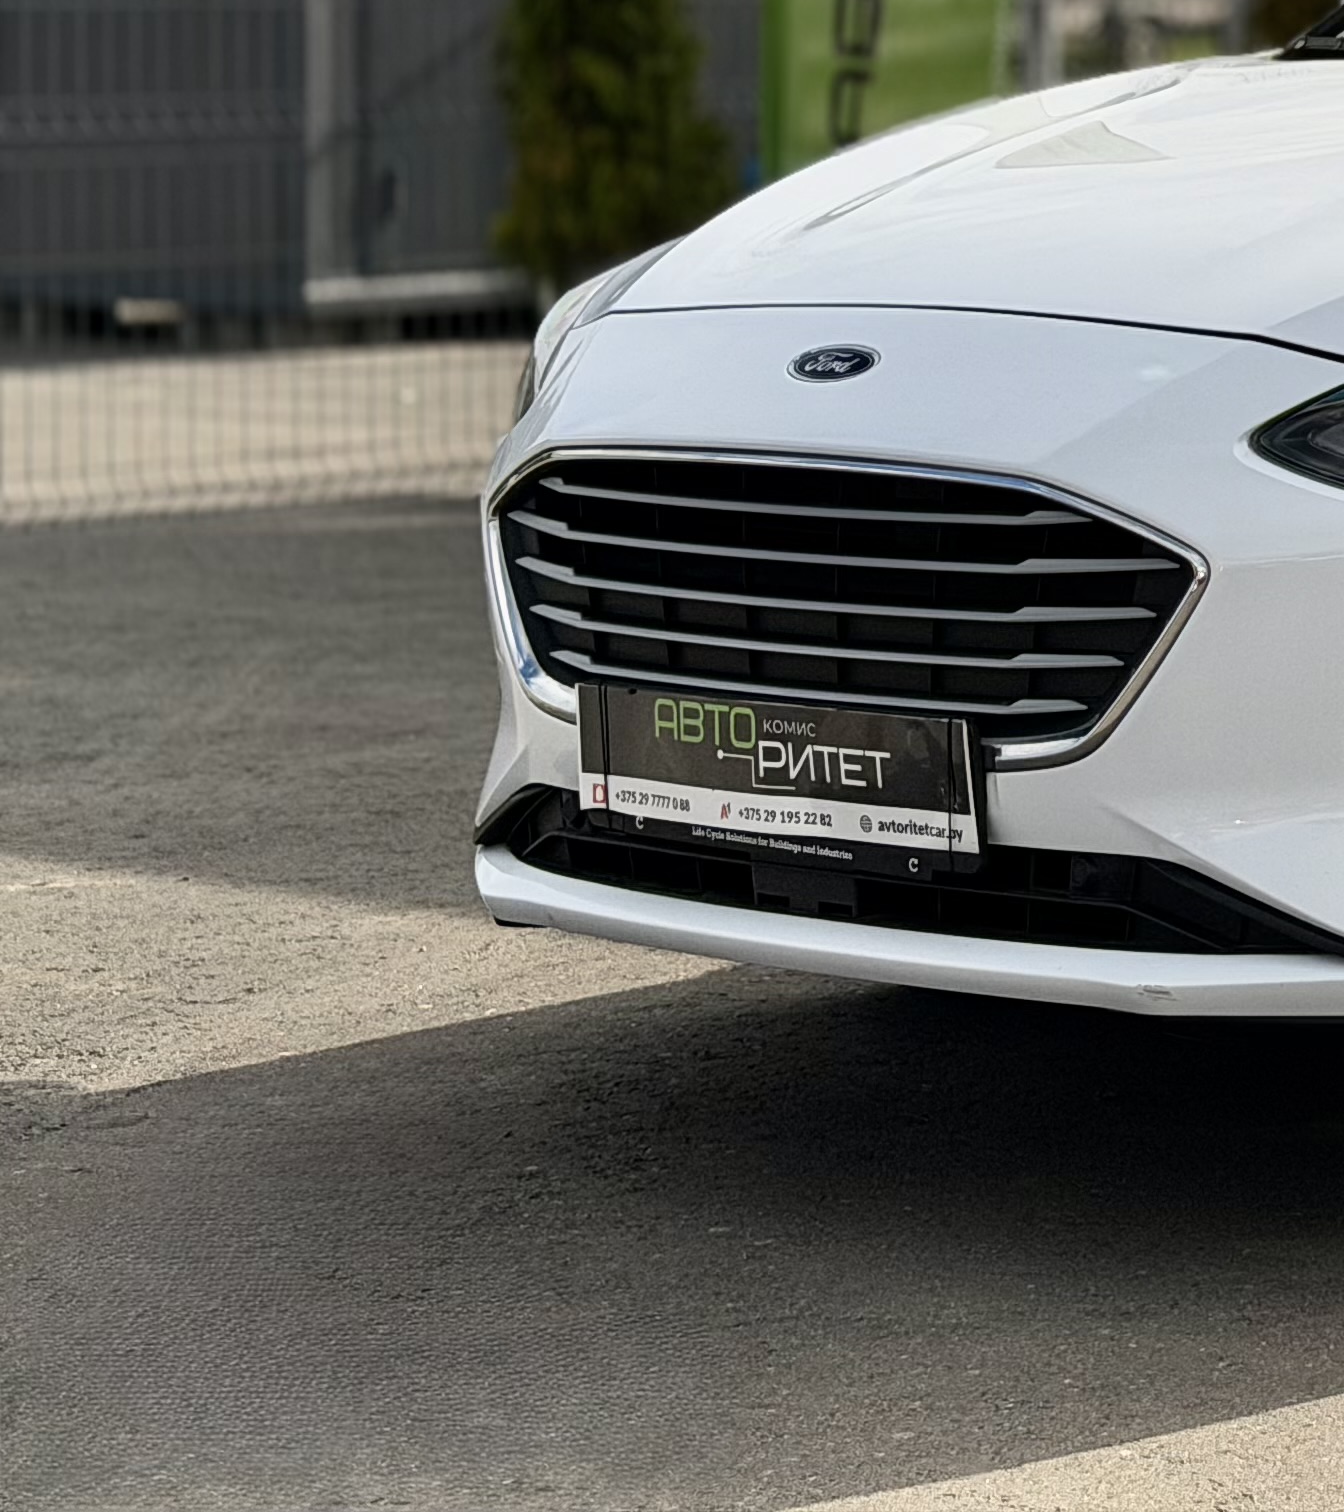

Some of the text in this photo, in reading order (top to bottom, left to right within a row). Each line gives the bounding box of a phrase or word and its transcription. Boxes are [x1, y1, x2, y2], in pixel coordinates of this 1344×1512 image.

[803, 350, 861, 374] Ford
[654, 697, 757, 750] АВТО
[762, 718, 816, 738] КОМИС
[757, 739, 891, 790] РИТЕТ
[615, 789, 637, 804] +375
[638, 791, 649, 806] 29
[650, 793, 671, 809] 7777
[738, 806, 833, 828] +375 29 195 22 82
[877, 819, 964, 844] avtoritetcar.by
